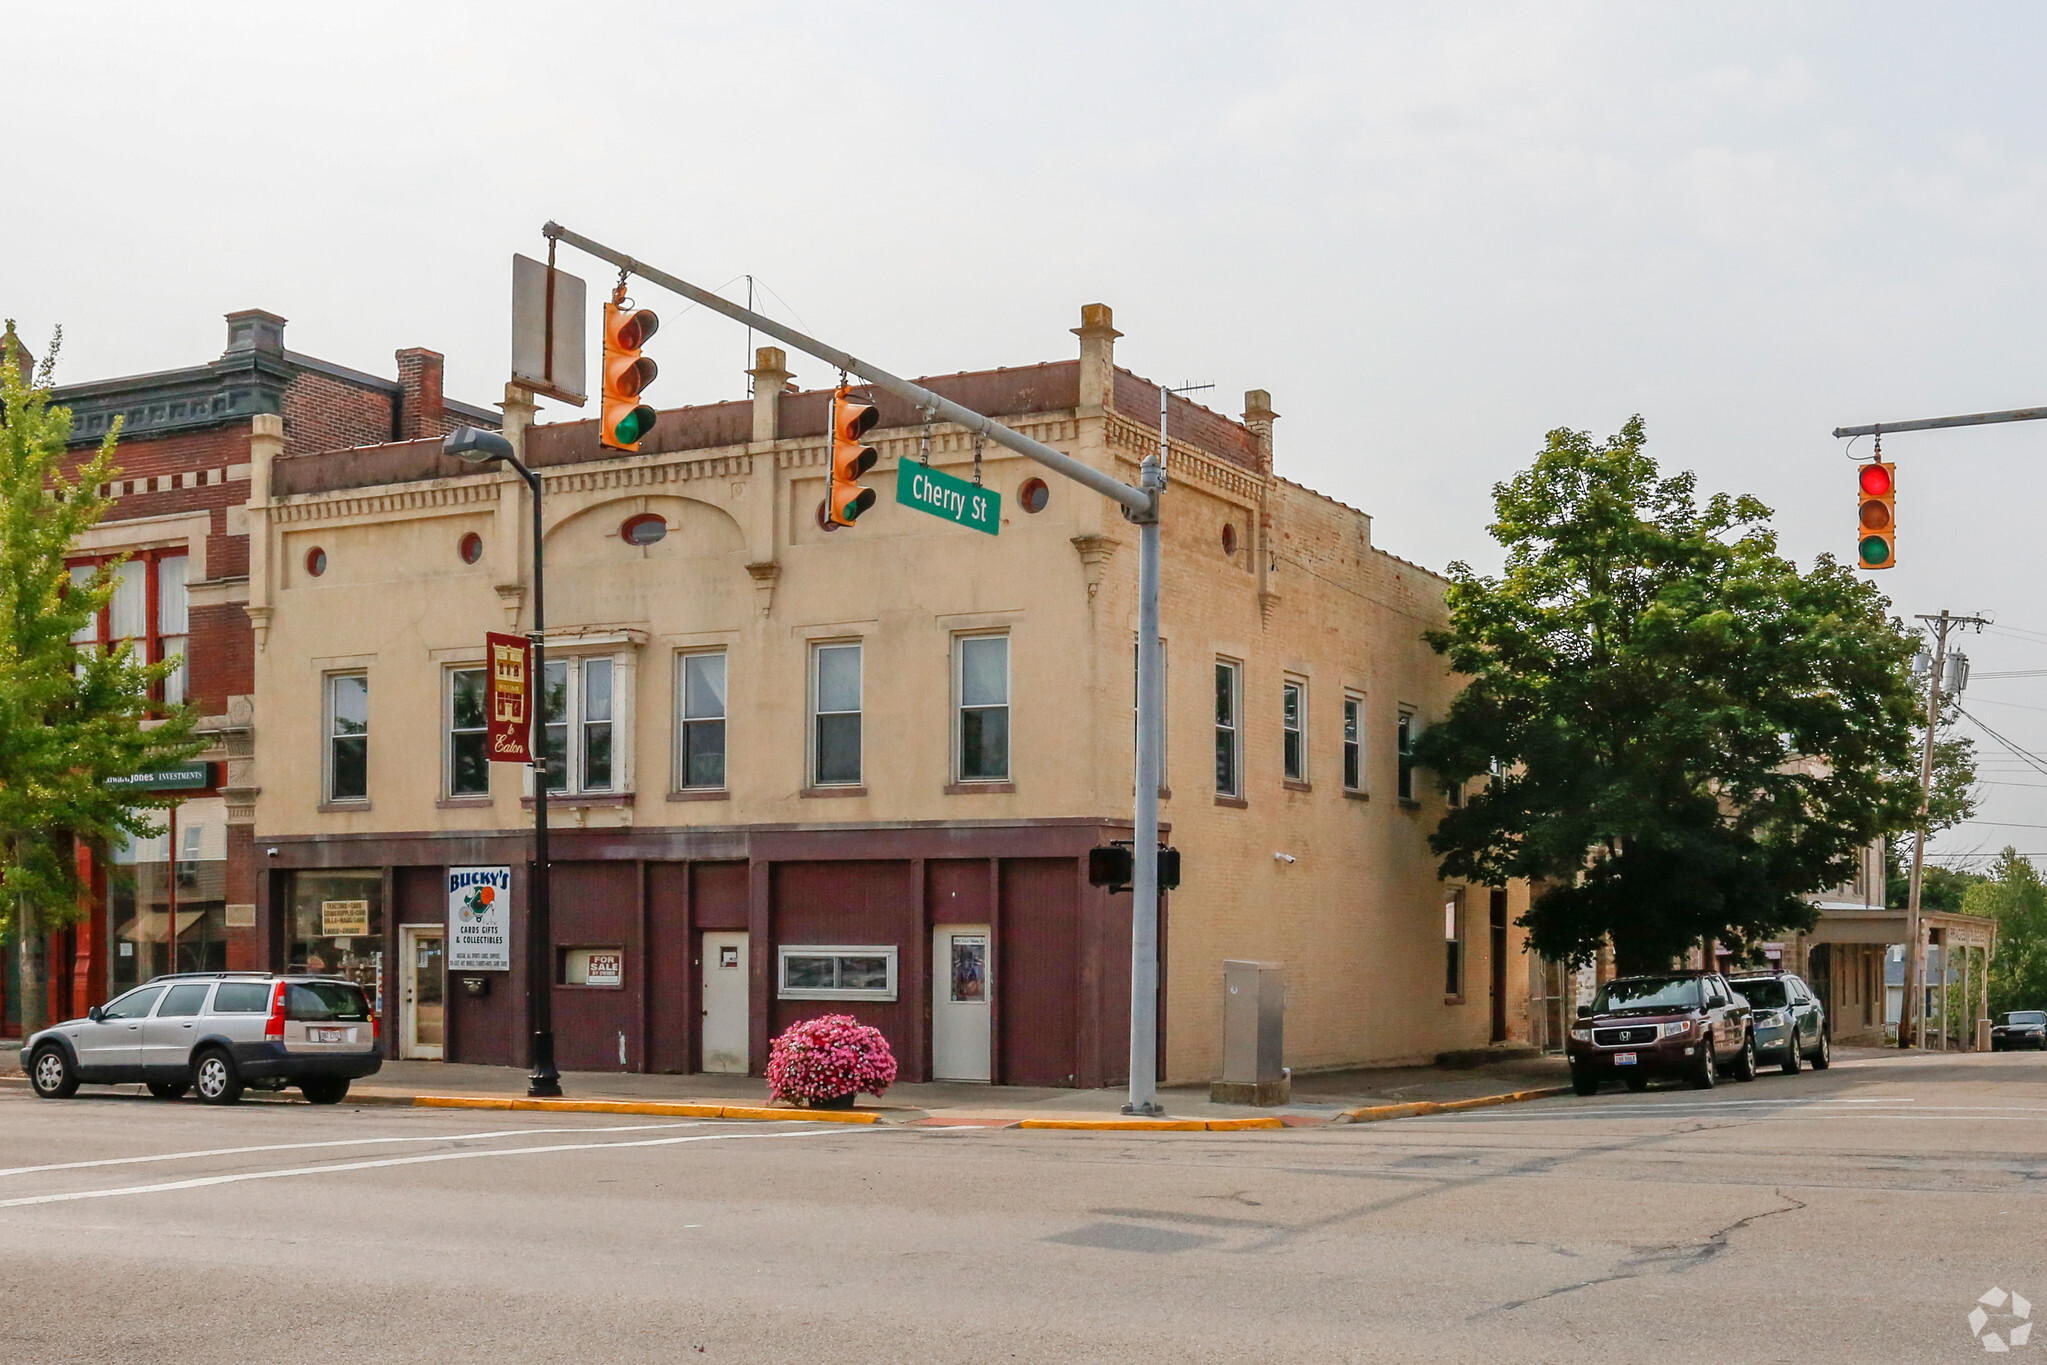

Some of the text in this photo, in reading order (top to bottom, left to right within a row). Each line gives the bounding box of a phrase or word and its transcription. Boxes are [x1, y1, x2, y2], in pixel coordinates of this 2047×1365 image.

[912, 474, 987, 522] Cherry St
[494, 734, 524, 754] Eaton
[129, 773, 154, 783] Jones
[158, 771, 203, 781] INVESTMENTS
[449, 869, 510, 894] BUCKY'S
[460, 926, 498, 934] CARDS GIFTS
[455, 936, 503, 944] & COLLECTIBLES
[590, 963, 619, 971] SALE
